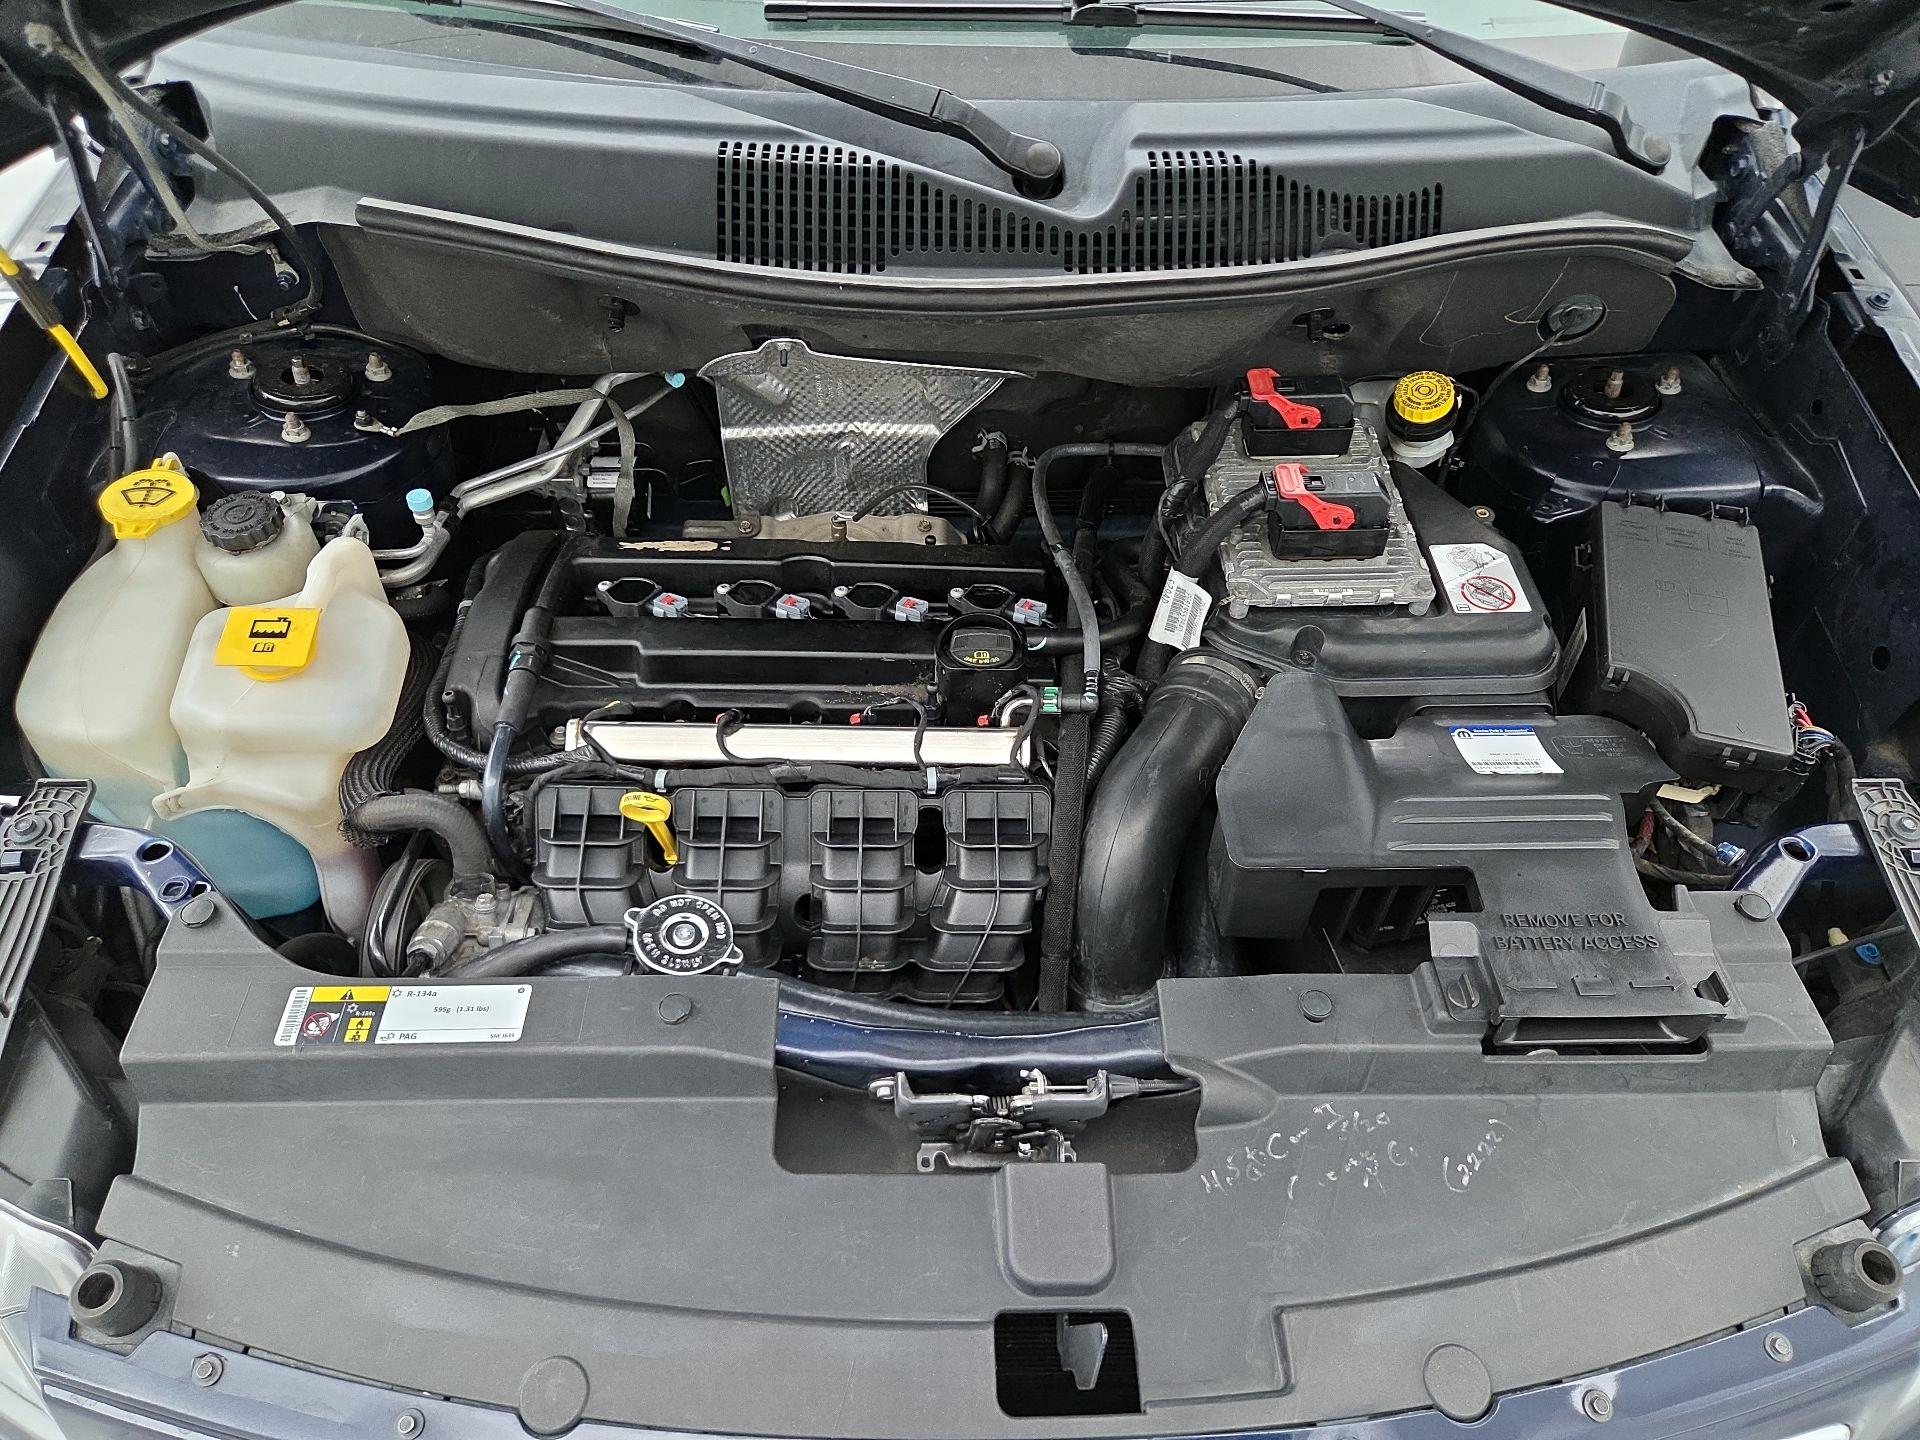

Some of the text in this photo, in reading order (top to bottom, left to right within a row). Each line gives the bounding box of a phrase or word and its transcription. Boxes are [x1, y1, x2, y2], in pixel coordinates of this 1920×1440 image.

[669, 898, 692, 908] NOT
[1500, 911, 1629, 929] REMOVE FOR
[1493, 934, 1660, 951] BATTERY ACCESS
[433, 1006, 452, 1014] 595g
[456, 1006, 475, 1014] (1.31
[398, 1032, 418, 1040] PAG
